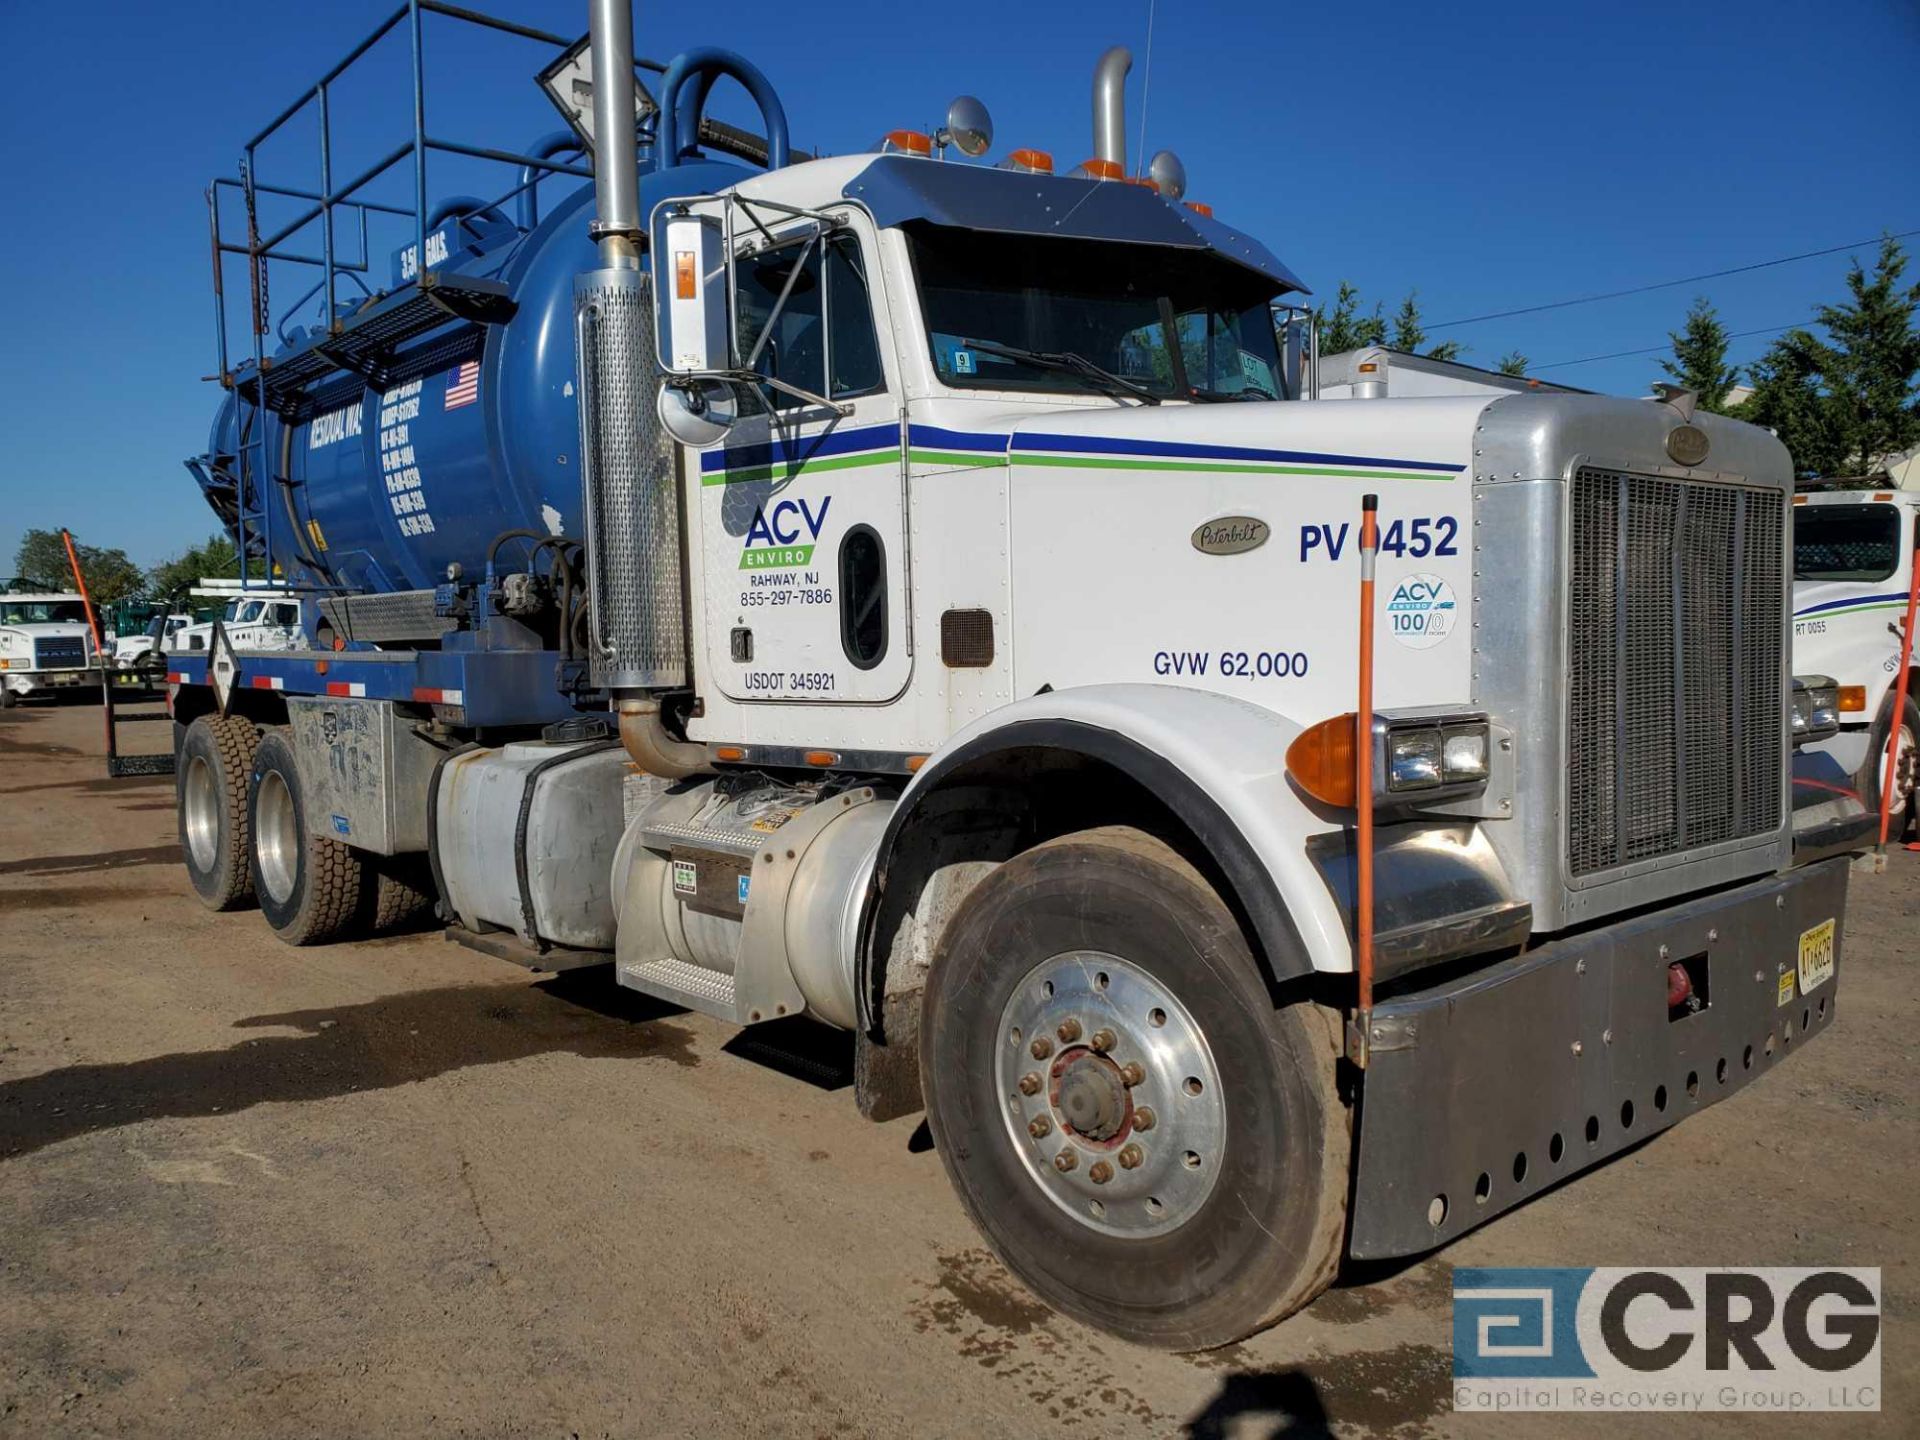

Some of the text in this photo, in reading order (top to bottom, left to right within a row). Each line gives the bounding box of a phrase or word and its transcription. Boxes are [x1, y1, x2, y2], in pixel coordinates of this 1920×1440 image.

[960, 354, 966, 366] 9
[310, 408, 345, 450] RESIDUAL
[745, 496, 832, 548] ACV
[1200, 524, 1262, 548] Peterbilt
[1300, 523, 1349, 562] PV
[747, 552, 804, 566] ENVIRO
[750, 573, 819, 587] RAHWAY, NJ
[740, 589, 832, 606] 855-297-7886
[1392, 582, 1443, 601] ACV
[1796, 621, 1826, 635] RT 0055
[1154, 652, 1308, 680] GVW 62,000
[745, 673, 835, 690] USDOT 345921
